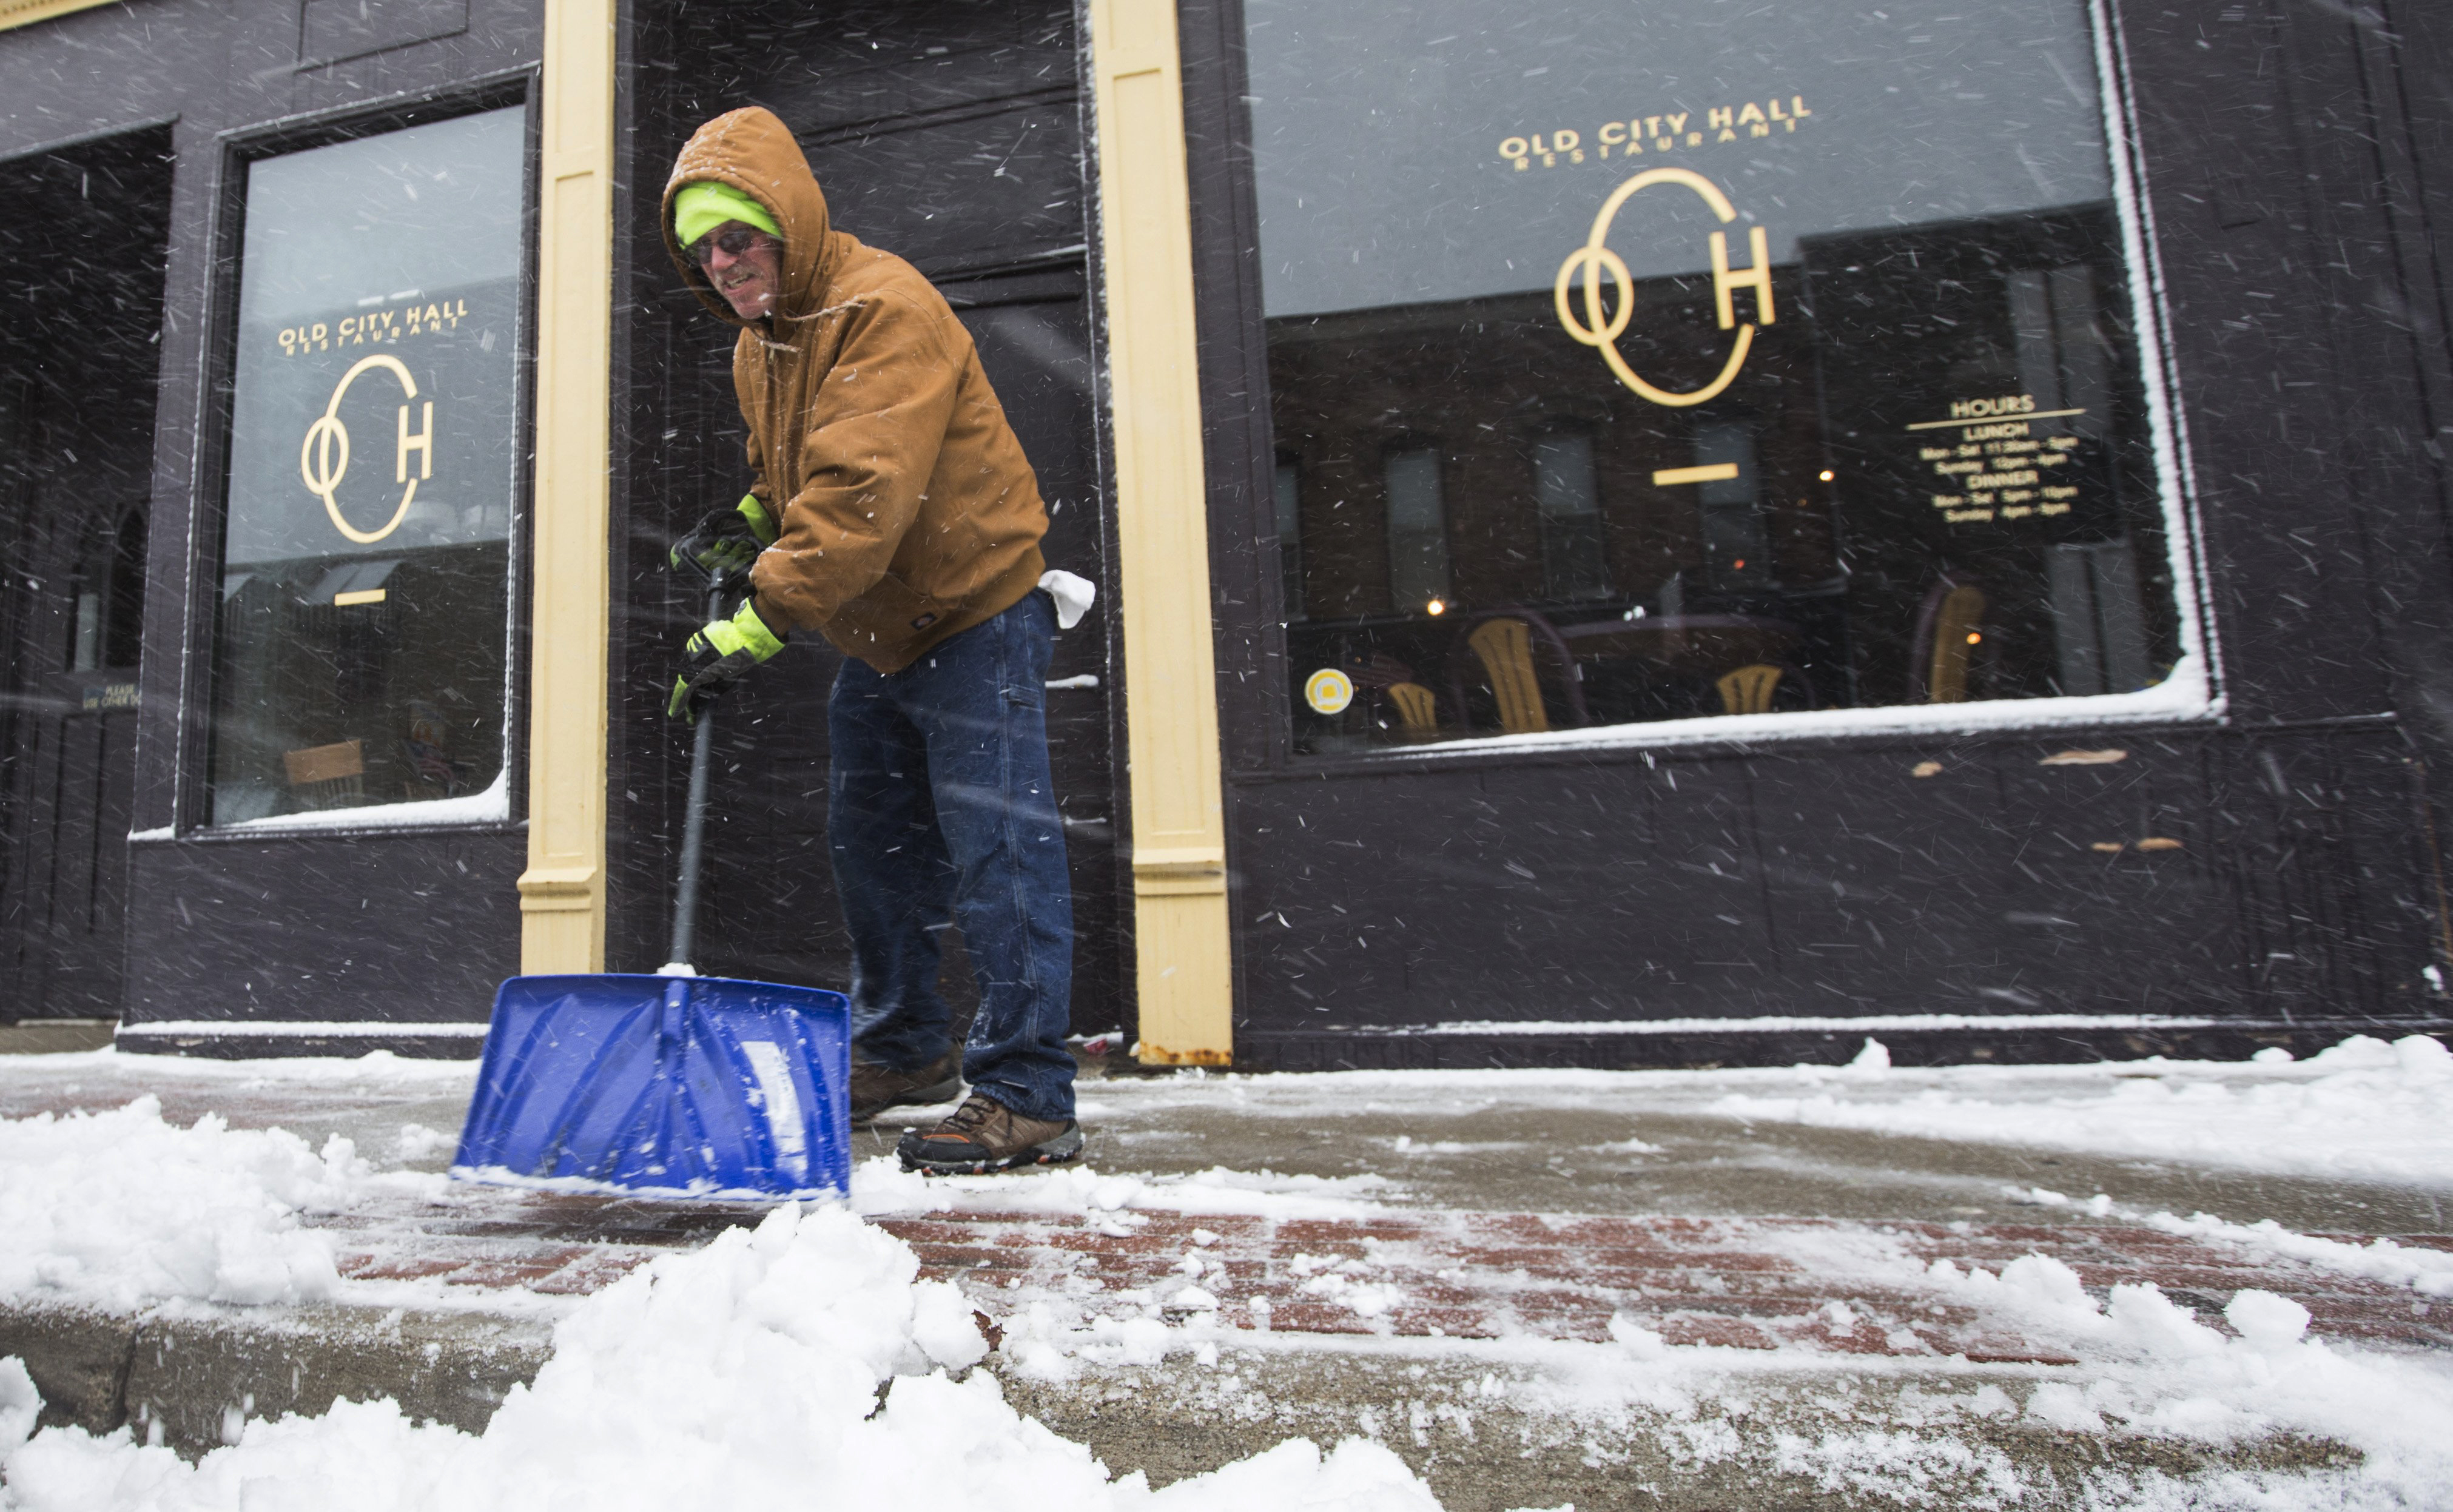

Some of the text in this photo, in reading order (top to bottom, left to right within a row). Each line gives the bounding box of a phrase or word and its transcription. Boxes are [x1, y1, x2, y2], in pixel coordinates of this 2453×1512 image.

[1499, 95, 1812, 159] OLD CITY HALL
[1514, 118, 1797, 172] RESTAURANT
[278, 298, 468, 347] OLD CITY HALL
[286, 317, 459, 357] RESTAURANT
[1951, 395, 2034, 417] HOURS
[1963, 422, 2028, 440] LUNCH
[1934, 461, 1984, 474] Sunday
[1967, 471, 2038, 489] DINNER
[1944, 509, 1993, 522] Sunday
[106, 685, 134, 695] PLEASE
[83, 697, 98, 710] USE
